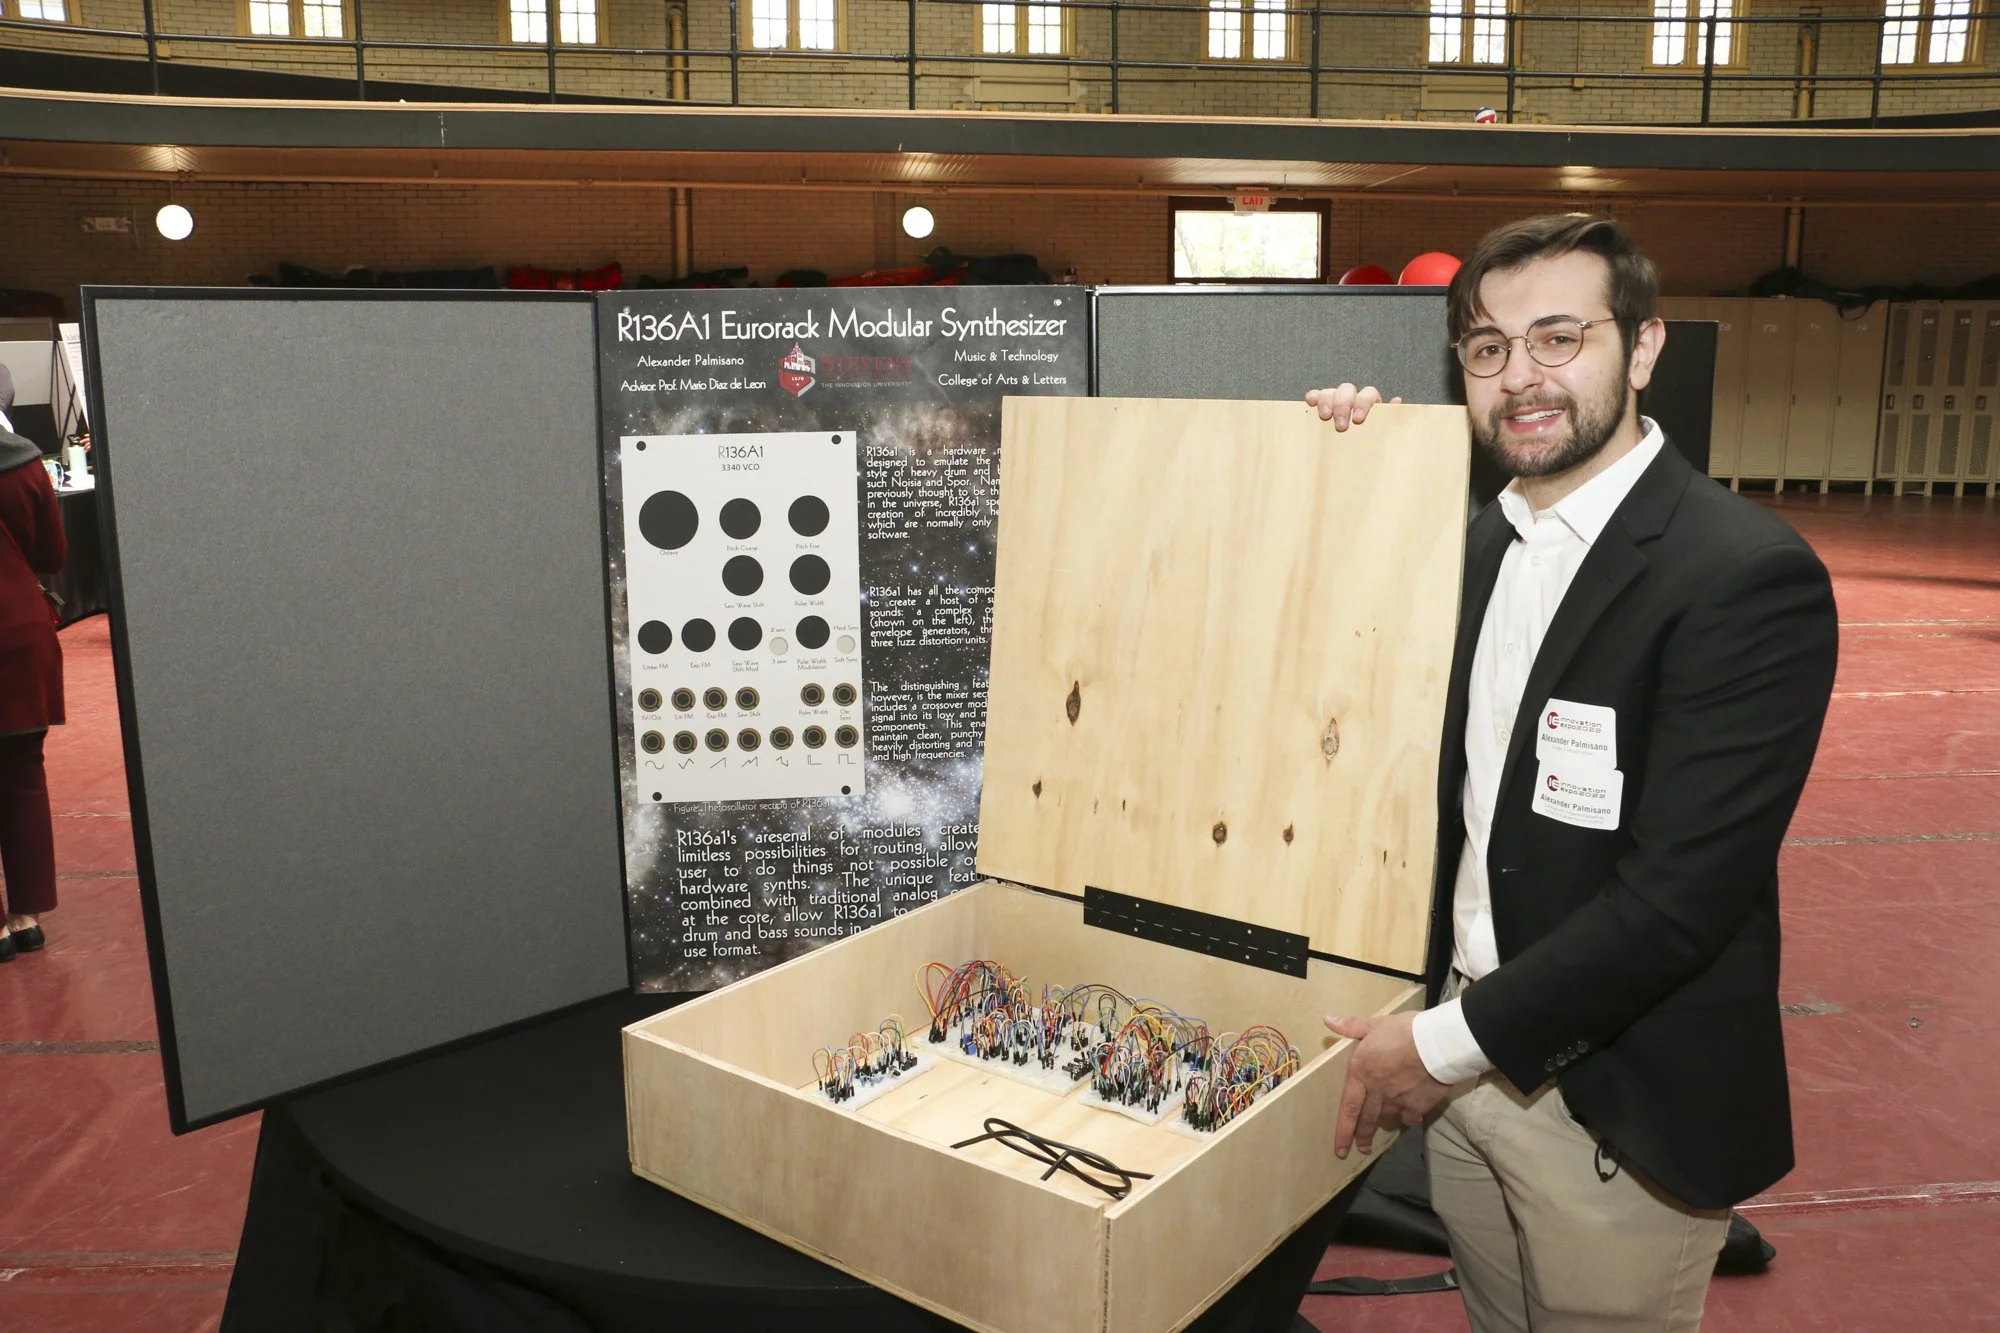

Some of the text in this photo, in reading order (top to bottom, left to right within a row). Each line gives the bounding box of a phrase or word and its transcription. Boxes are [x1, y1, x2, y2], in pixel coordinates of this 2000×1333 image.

[618, 308, 1067, 342] R136A1 Eurorack Modular Synthesizer
[637, 355, 744, 367] Alexander Palmisano
[955, 349, 1058, 362] Music & Technology
[659, 381, 677, 391] Prof.
[680, 379, 706, 390] Mario
[709, 379, 727, 390] Diaz
[730, 379, 741, 389] de
[744, 379, 766, 389] Leon
[939, 373, 1067, 387] College of Arts & Letters
[718, 445, 763, 459] R136A1
[866, 446, 898, 456] R136a1
[909, 448, 915, 456] is
[944, 445, 986, 455] hardware
[866, 456, 907, 468] designed
[934, 456, 968, 466] emulate
[976, 455, 990, 465] the
[867, 465, 990, 478] style of heavy drum and
[867, 476, 972, 488] such Noisia and Spor.
[868, 486, 985, 498] previously thought to be
[882, 498, 896, 508] the
[903, 500, 942, 508] universe,
[949, 496, 979, 507] R136a1
[868, 506, 980, 518] creation of incredibly
[868, 516, 992, 528] which are normally only
[868, 529, 910, 539] software.
[869, 584, 959, 596] R136a1 has all the
[940, 595, 959, 605] host
[968, 594, 978, 604] of
[870, 606, 903, 617] sounds:
[935, 604, 972, 615] complex
[870, 617, 904, 628] (shown
[932, 615, 946, 625] the
[954, 612, 975, 625] left),
[870, 625, 970, 638] envelope generators,
[871, 635, 988, 647] three fuzz distortion units.
[871, 679, 959, 692] The distinguishing
[871, 692, 913, 702] however,
[917, 692, 923, 700] is
[928, 689, 941, 700] the
[872, 701, 907, 712] includes
[922, 701, 962, 710] crossover
[872, 708, 976, 723] signal into its low and
[872, 718, 962, 732] components. This
[1560, 718, 1601, 727] innovation
[1560, 723, 1601, 733] expo2022
[917, 729, 942, 740] clean,
[951, 728, 983, 739] punchy
[872, 737, 972, 751] heavily distorting and
[1542, 734, 1569, 746] Alexander
[1571, 740, 1608, 751] Palmisano
[873, 750, 966, 761] and high frequencies.
[1560, 782, 1606, 793] innovation
[1560, 787, 1605, 799] expo2022
[1541, 794, 1570, 808] Alexander
[1573, 804, 1611, 814] Palmisano
[677, 822, 921, 846] R136a1's aresenal of modules
[678, 840, 926, 862] limitless possibilities for routing,
[679, 852, 948, 879] user to do things not possible
[680, 871, 933, 894] hardware synths. The unique
[681, 885, 938, 910] combined with traditional analog
[682, 905, 881, 926] at the core, allow R136a1
[683, 924, 843, 942] drum and bass sounds
[684, 942, 760, 957] use format.
